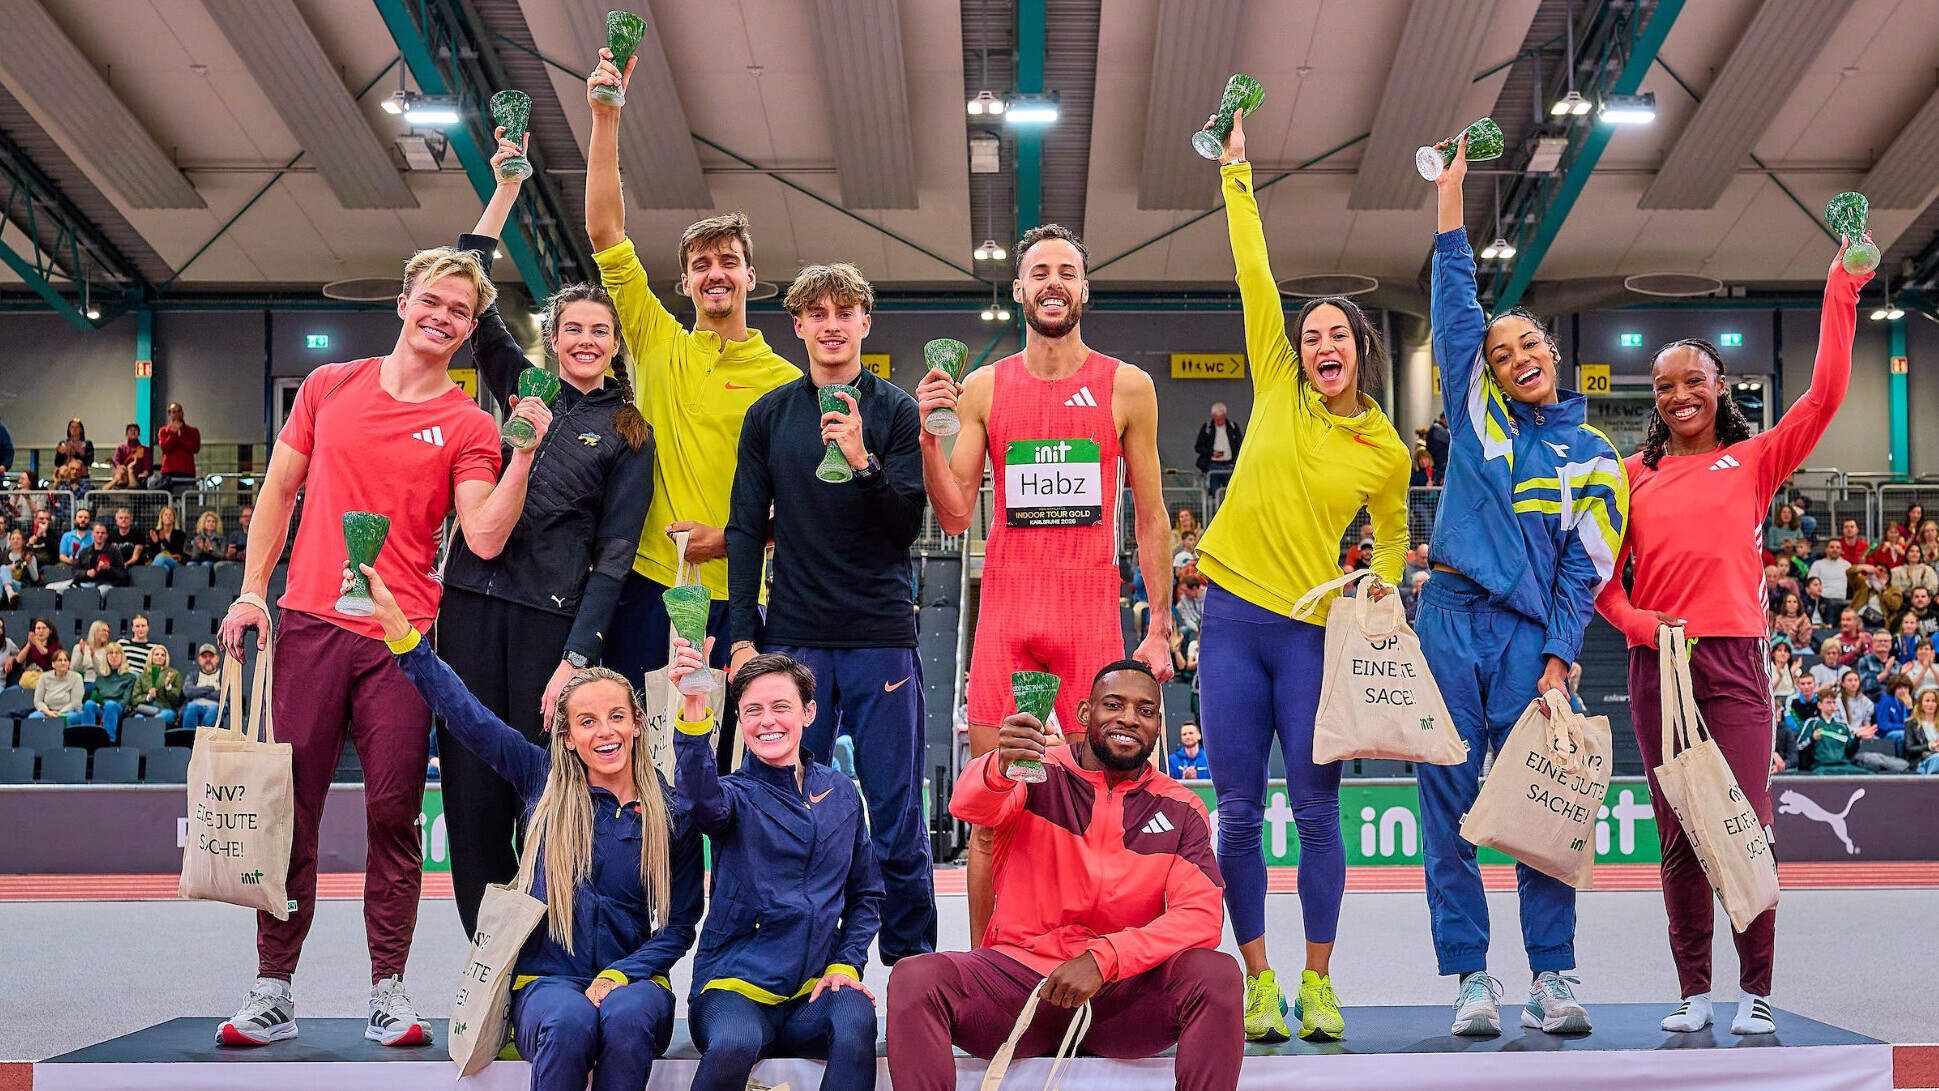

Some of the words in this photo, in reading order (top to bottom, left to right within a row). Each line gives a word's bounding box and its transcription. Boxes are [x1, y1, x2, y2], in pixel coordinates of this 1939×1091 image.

[1205, 362, 1225, 373] WC
[1587, 375, 1607, 391] 20
[1035, 440, 1072, 463] init
[1021, 471, 1086, 495] Habz
[1015, 511, 1045, 519] INDOOR
[1068, 510, 1091, 518] GOLD
[1353, 659, 1397, 678] EINE
[1365, 687, 1416, 706] SACE!
[1525, 750, 1567, 786] EINE
[1526, 783, 1590, 825] SACHE!
[215, 813, 258, 830] JUTE
[199, 834, 244, 858] SCHE!
[240, 869, 264, 885] init
